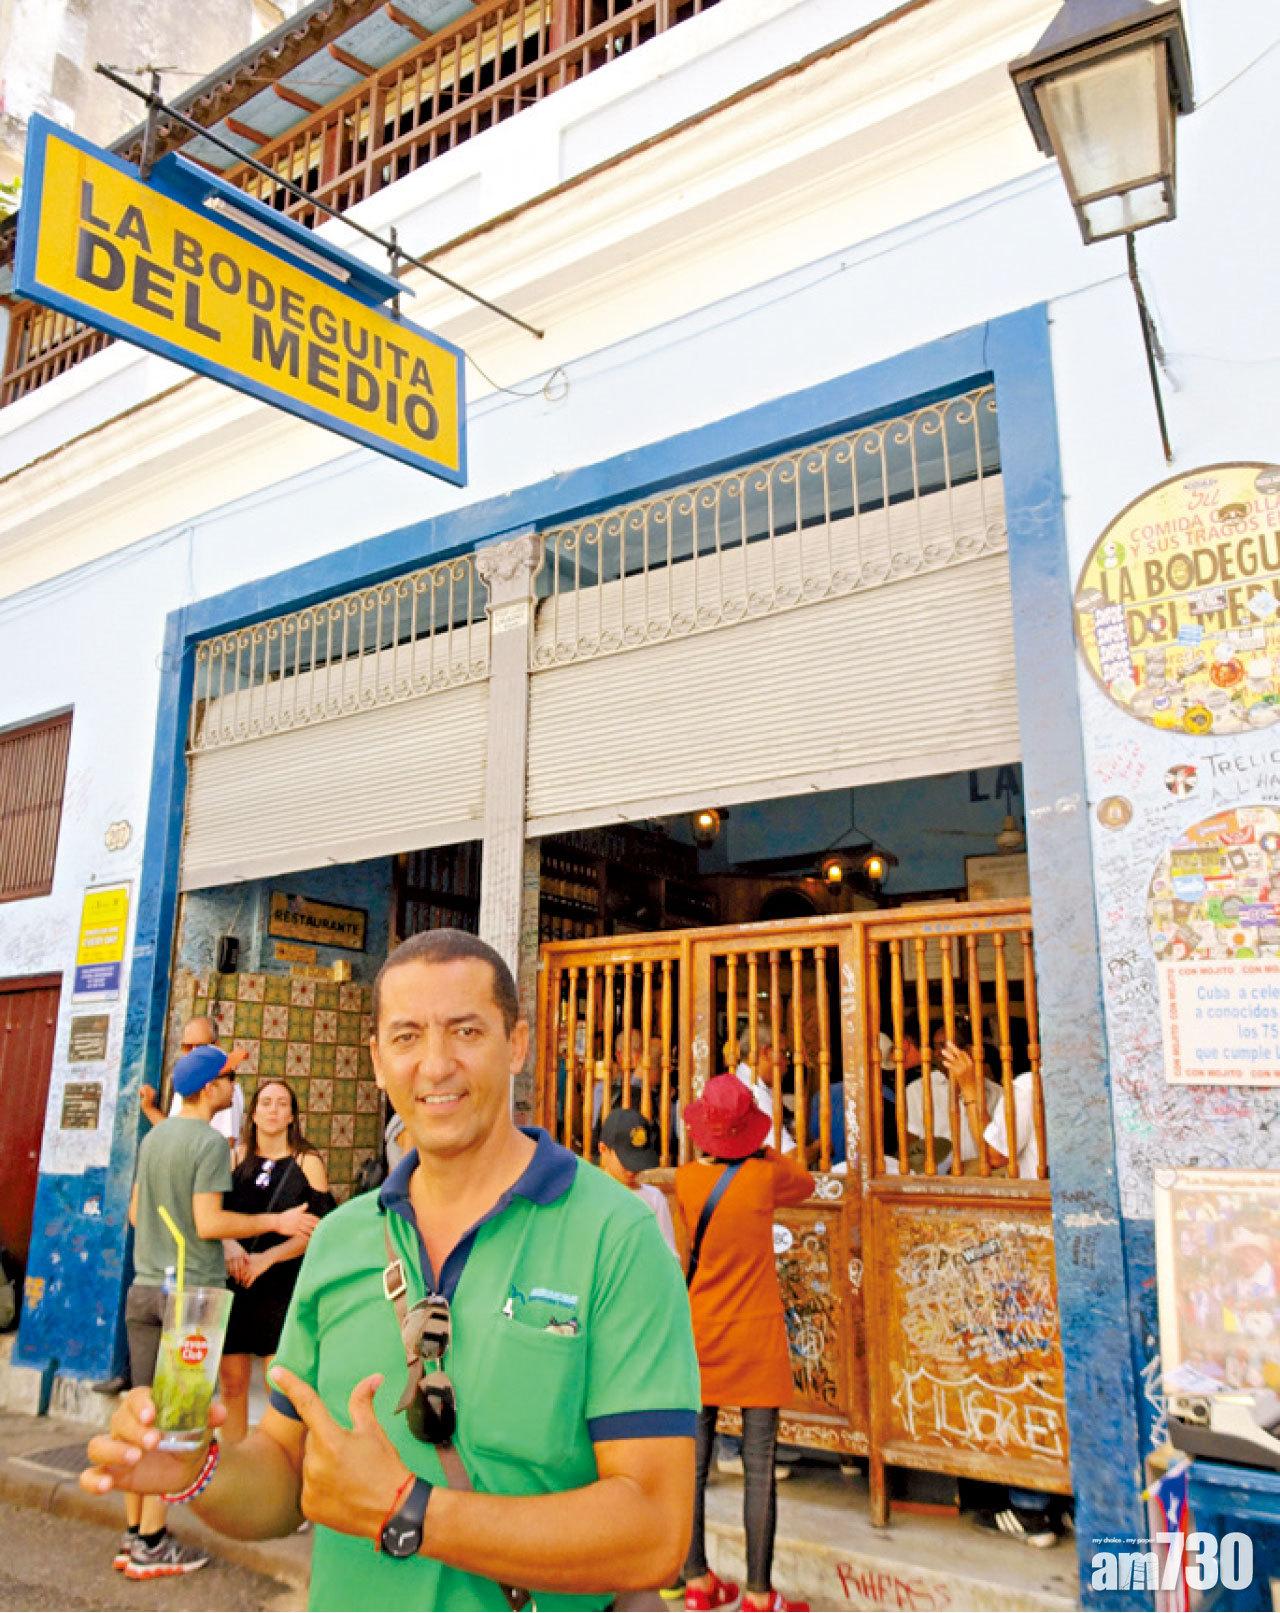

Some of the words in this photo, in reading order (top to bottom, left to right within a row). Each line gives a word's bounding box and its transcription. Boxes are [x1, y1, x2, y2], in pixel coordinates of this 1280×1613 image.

[81, 180, 152, 253] LA
[173, 229, 434, 395] BODEGUITA
[75, 227, 221, 342] DEL
[252, 314, 440, 442] MEDIO
[1130, 513, 1204, 543] COMIDA
[1147, 535, 1180, 555] SUS
[1186, 517, 1260, 545] TRAGOS
[1144, 530, 1280, 598] BODEGU
[969, 766, 1020, 801] LA
[274, 909, 360, 935] RESTAURANTE
[1197, 985, 1231, 1000] Cuba
[1207, 1004, 1278, 1019] conocidos
[1238, 1023, 1259, 1039] los
